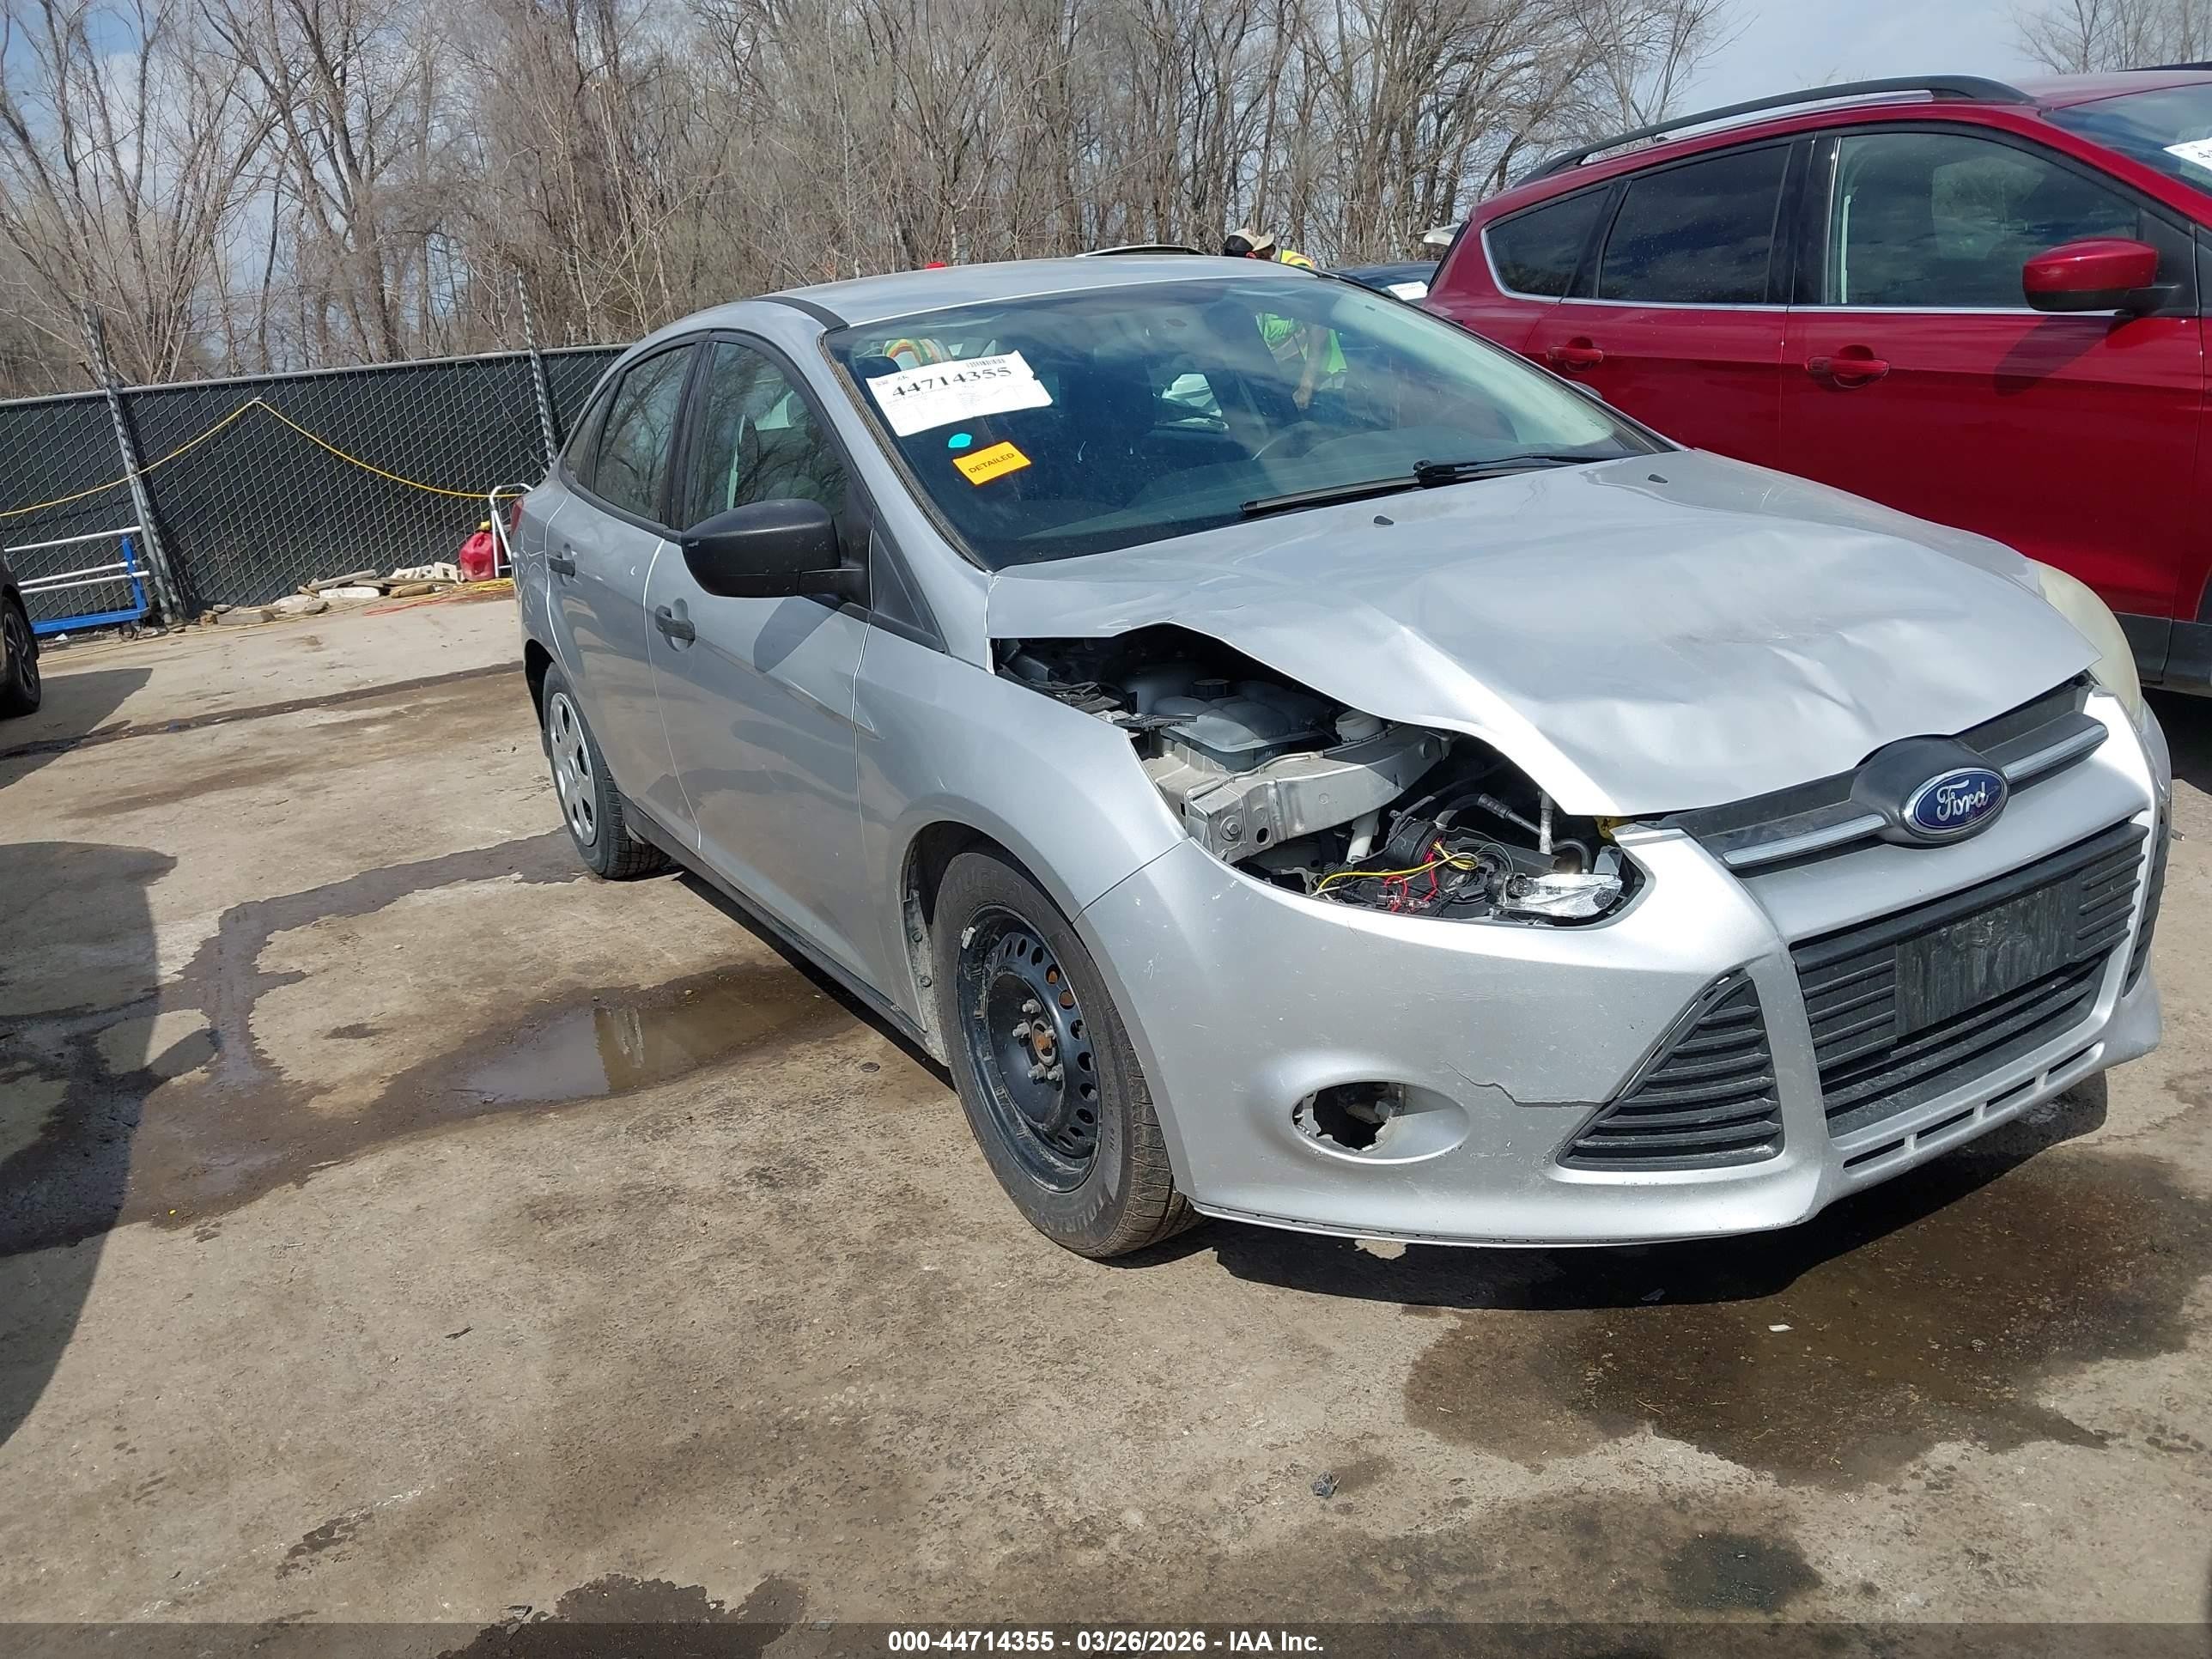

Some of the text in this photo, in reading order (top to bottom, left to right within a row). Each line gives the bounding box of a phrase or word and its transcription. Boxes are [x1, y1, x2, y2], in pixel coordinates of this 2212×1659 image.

[892, 367, 1012, 397] 44714355
[968, 453, 1015, 474] DETAILED
[1936, 779, 1990, 822] Ford
